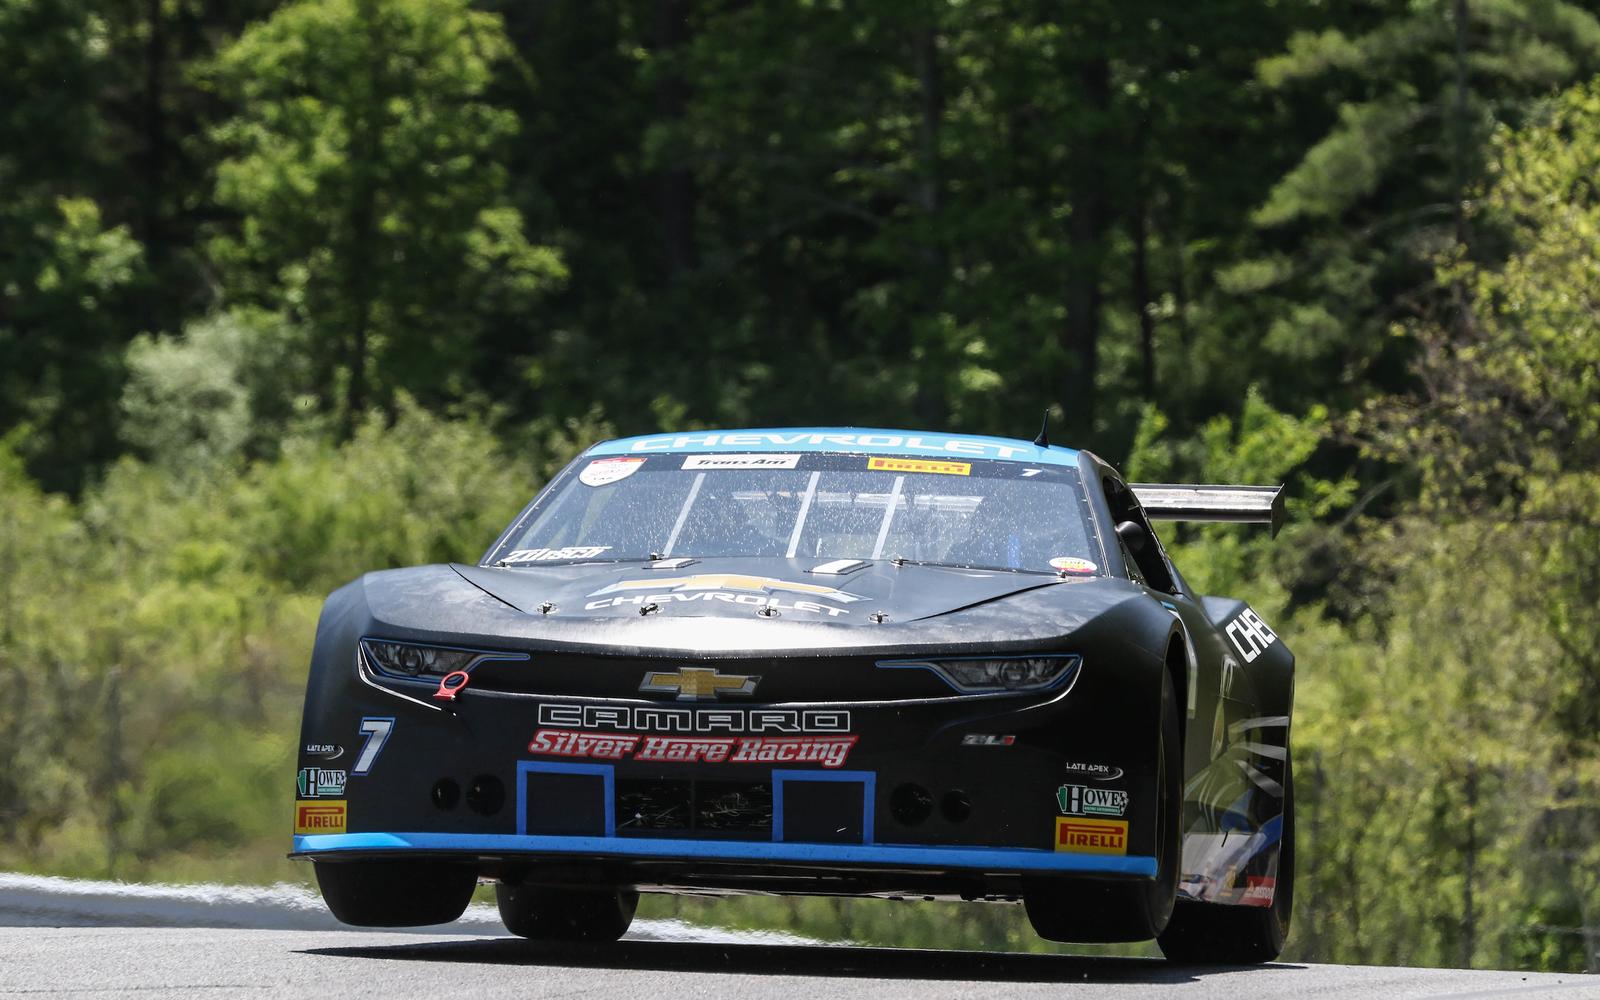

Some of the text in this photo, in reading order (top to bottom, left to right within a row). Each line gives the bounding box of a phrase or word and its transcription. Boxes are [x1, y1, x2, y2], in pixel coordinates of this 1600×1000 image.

[631, 434, 1028, 458] CHEVROLET
[584, 592, 850, 617] CHEVROLET
[1225, 606, 1278, 664] CHE
[538, 703, 850, 732] CAMARO
[306, 744, 321, 752] LATE
[351, 717, 396, 776] 7
[529, 731, 857, 767] Silver Hare Racing
[1066, 762, 1109, 773] LATE APEX
[1064, 785, 1120, 814] HOWE
[299, 806, 345, 828] PIRELLI
[1059, 822, 1125, 849] PIRELLI
